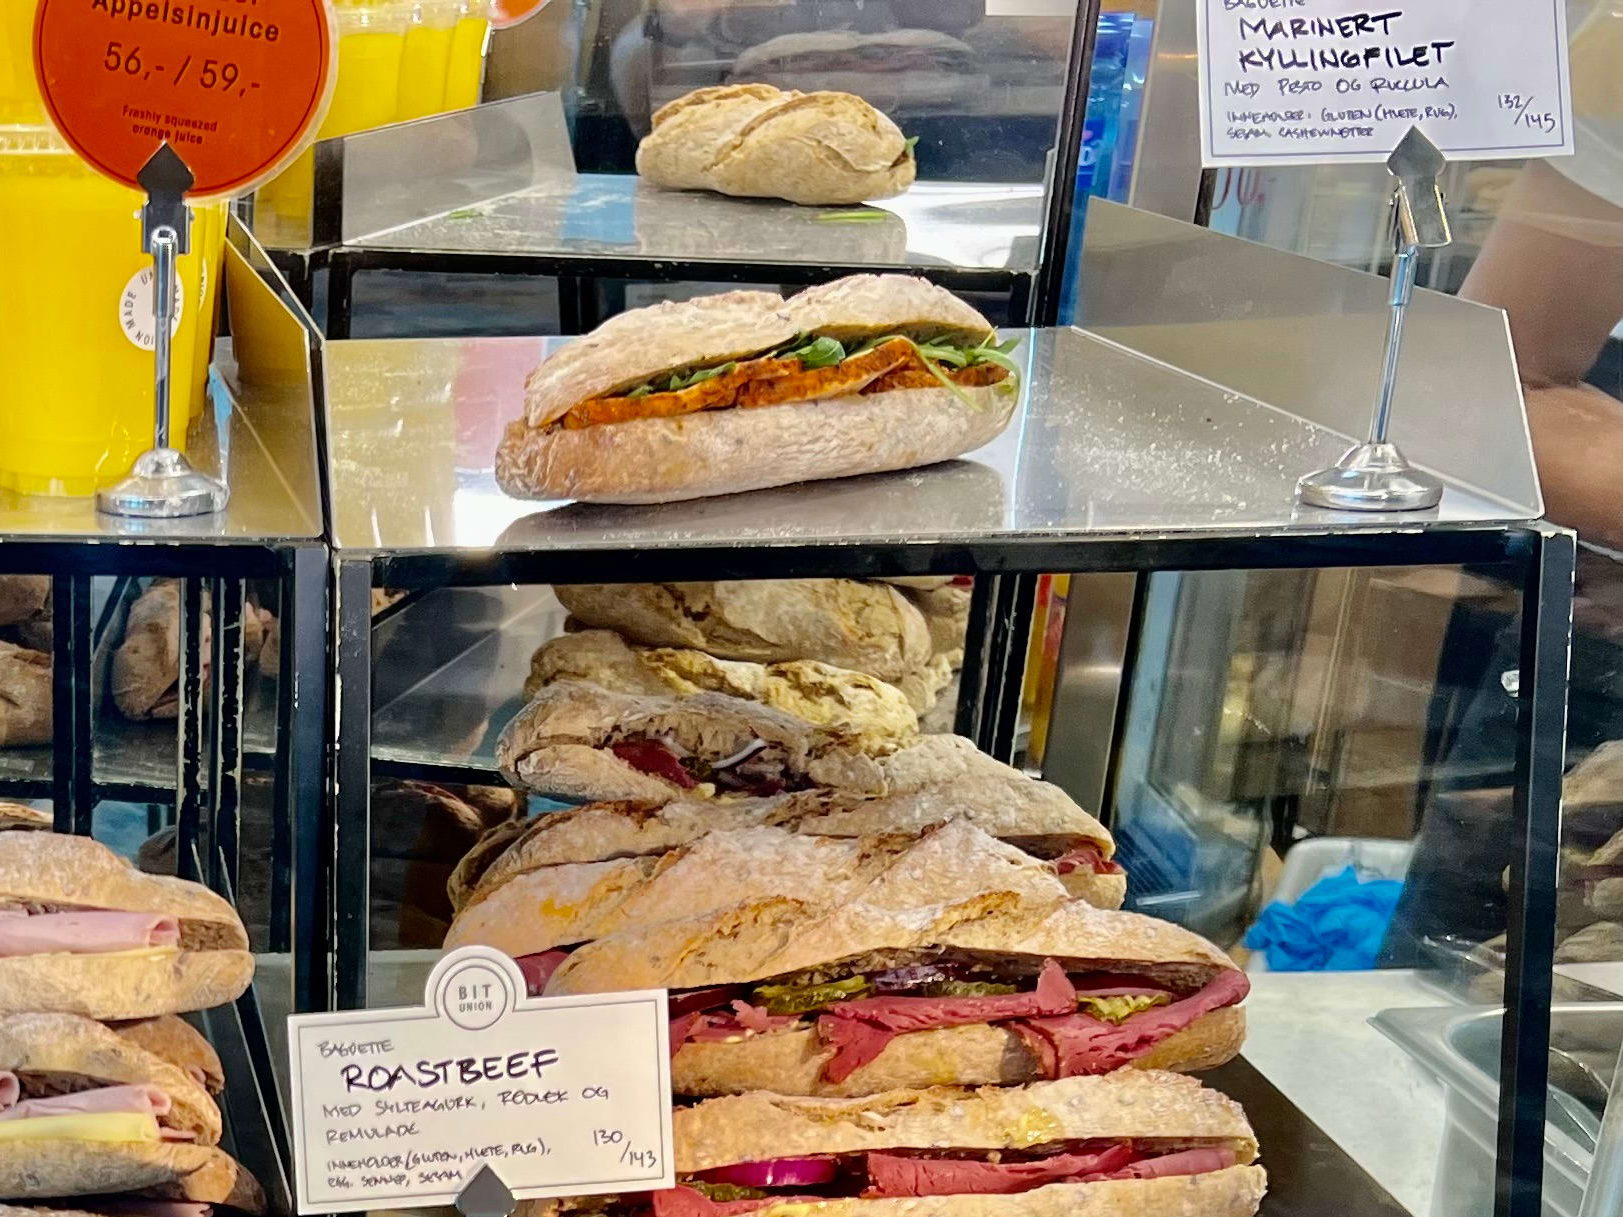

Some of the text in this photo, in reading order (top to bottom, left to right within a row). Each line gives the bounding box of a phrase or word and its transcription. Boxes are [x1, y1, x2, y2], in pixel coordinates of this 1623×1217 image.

[1239, 11, 1402, 41] MARINERT
[104, 41, 164, 80] 56,-
[199, 59, 259, 98] 59,-
[1239, 41, 1455, 73] KYLLINGFILET
[1224, 77, 1450, 98] MED PESTO OG RUCCULA
[122, 104, 218, 132] Freshly squeezed
[132, 124, 203, 144] orange juice
[458, 984, 491, 1001] BIT
[459, 1000, 492, 1013] UNION
[317, 1039, 394, 1058] BAGUETTE
[340, 1048, 560, 1094] ROASTBEEF
[322, 1103, 362, 1119] MED
[581, 1085, 609, 1100] OG
[326, 1122, 419, 1145] REMULADE
